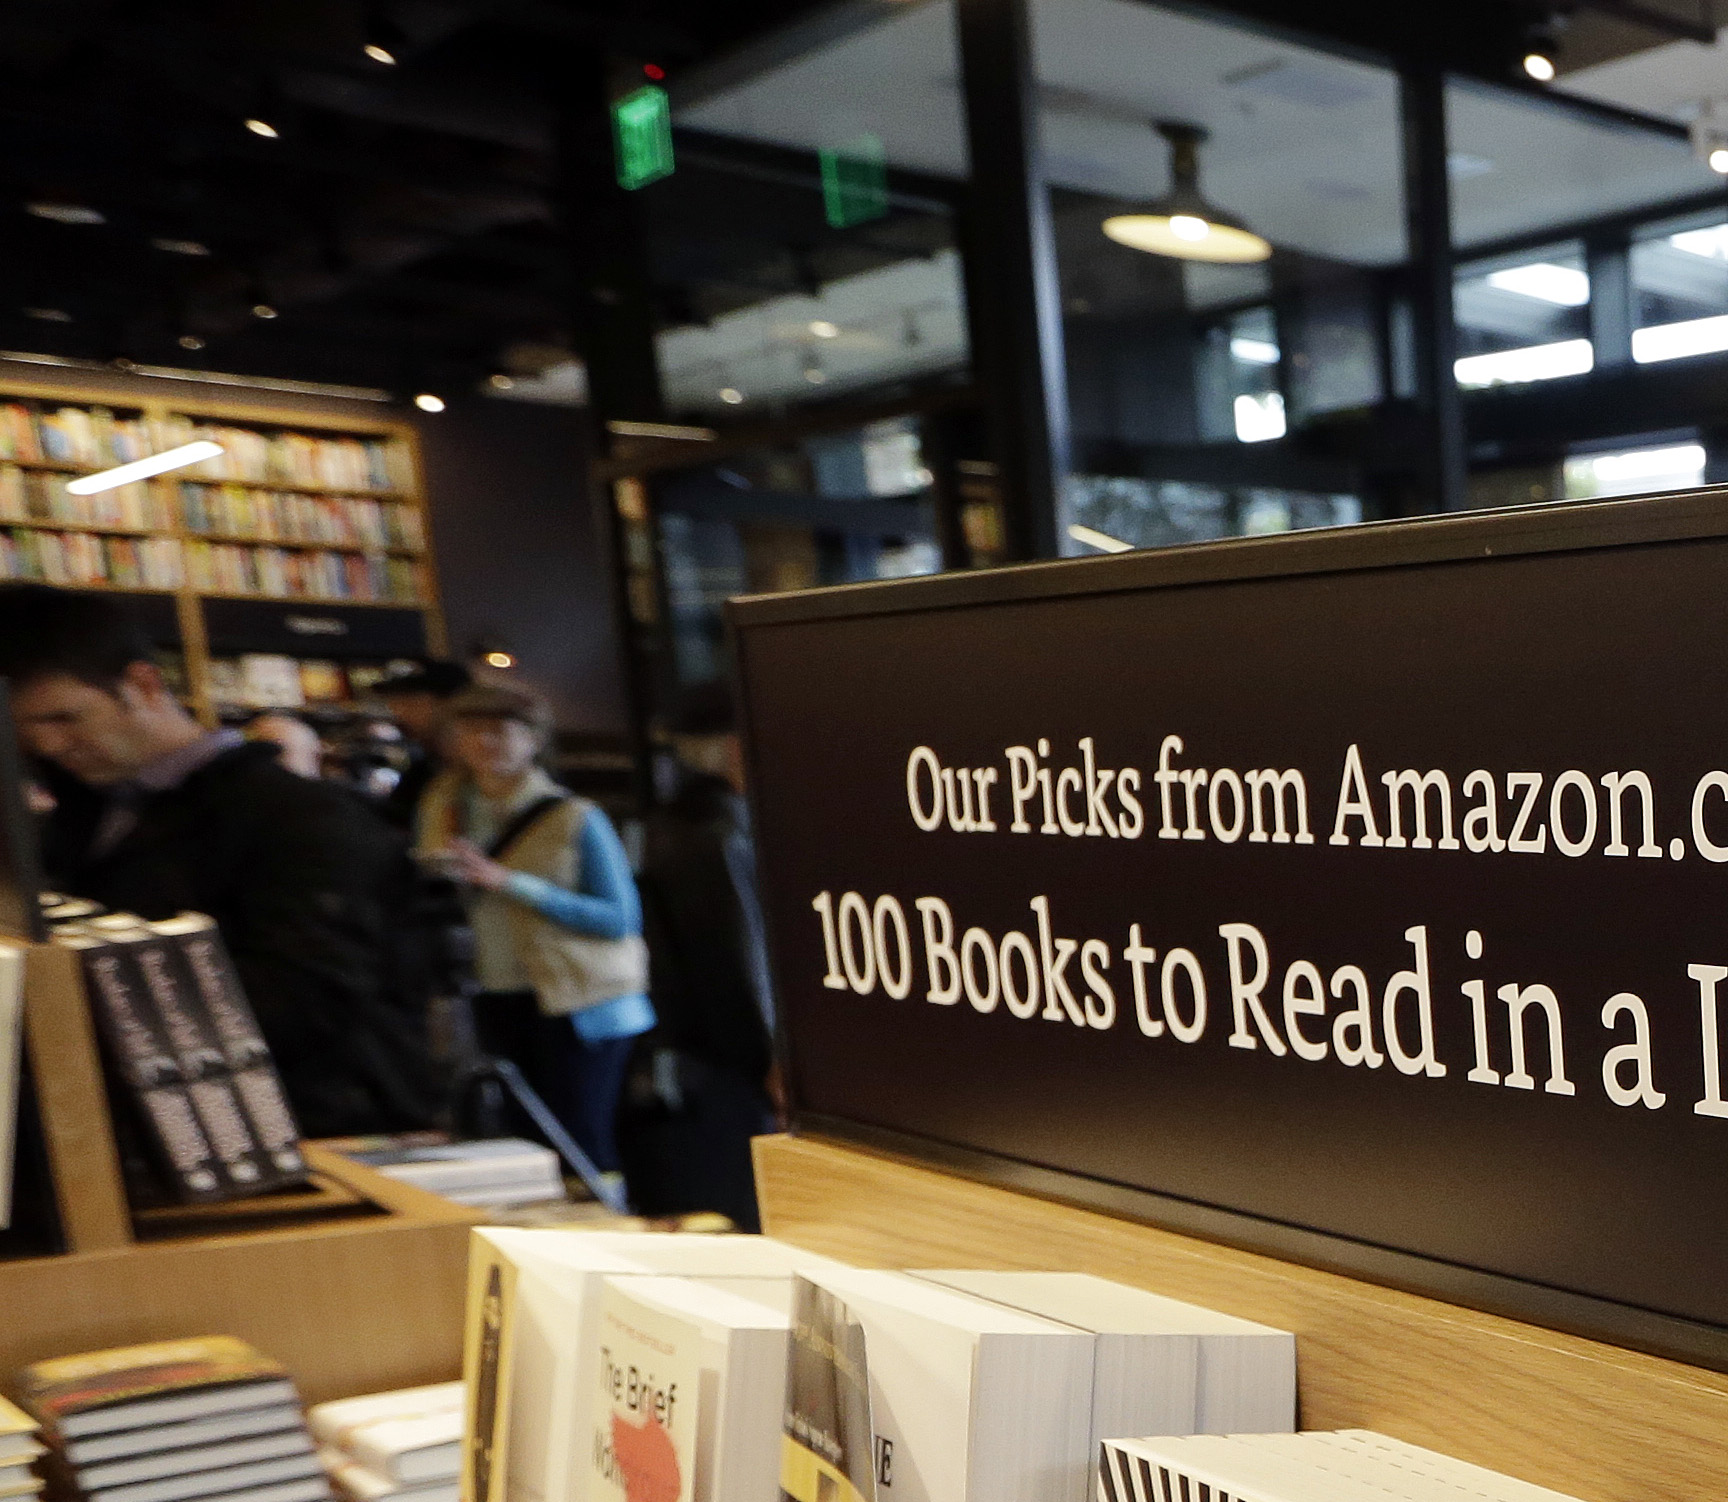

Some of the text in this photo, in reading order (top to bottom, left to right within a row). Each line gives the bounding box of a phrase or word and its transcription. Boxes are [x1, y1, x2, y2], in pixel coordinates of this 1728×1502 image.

[905, 745, 997, 832] Our
[1004, 736, 1144, 839] Picks
[1153, 734, 1314, 845] from
[811, 890, 913, 997] 100
[922, 890, 1118, 1031] Books
[1122, 922, 1207, 1043] to
[1218, 922, 1447, 1078] Read
[1460, 936, 1575, 1096] in
[1600, 991, 1666, 1110] a
[625, 1364, 678, 1430] Brief
